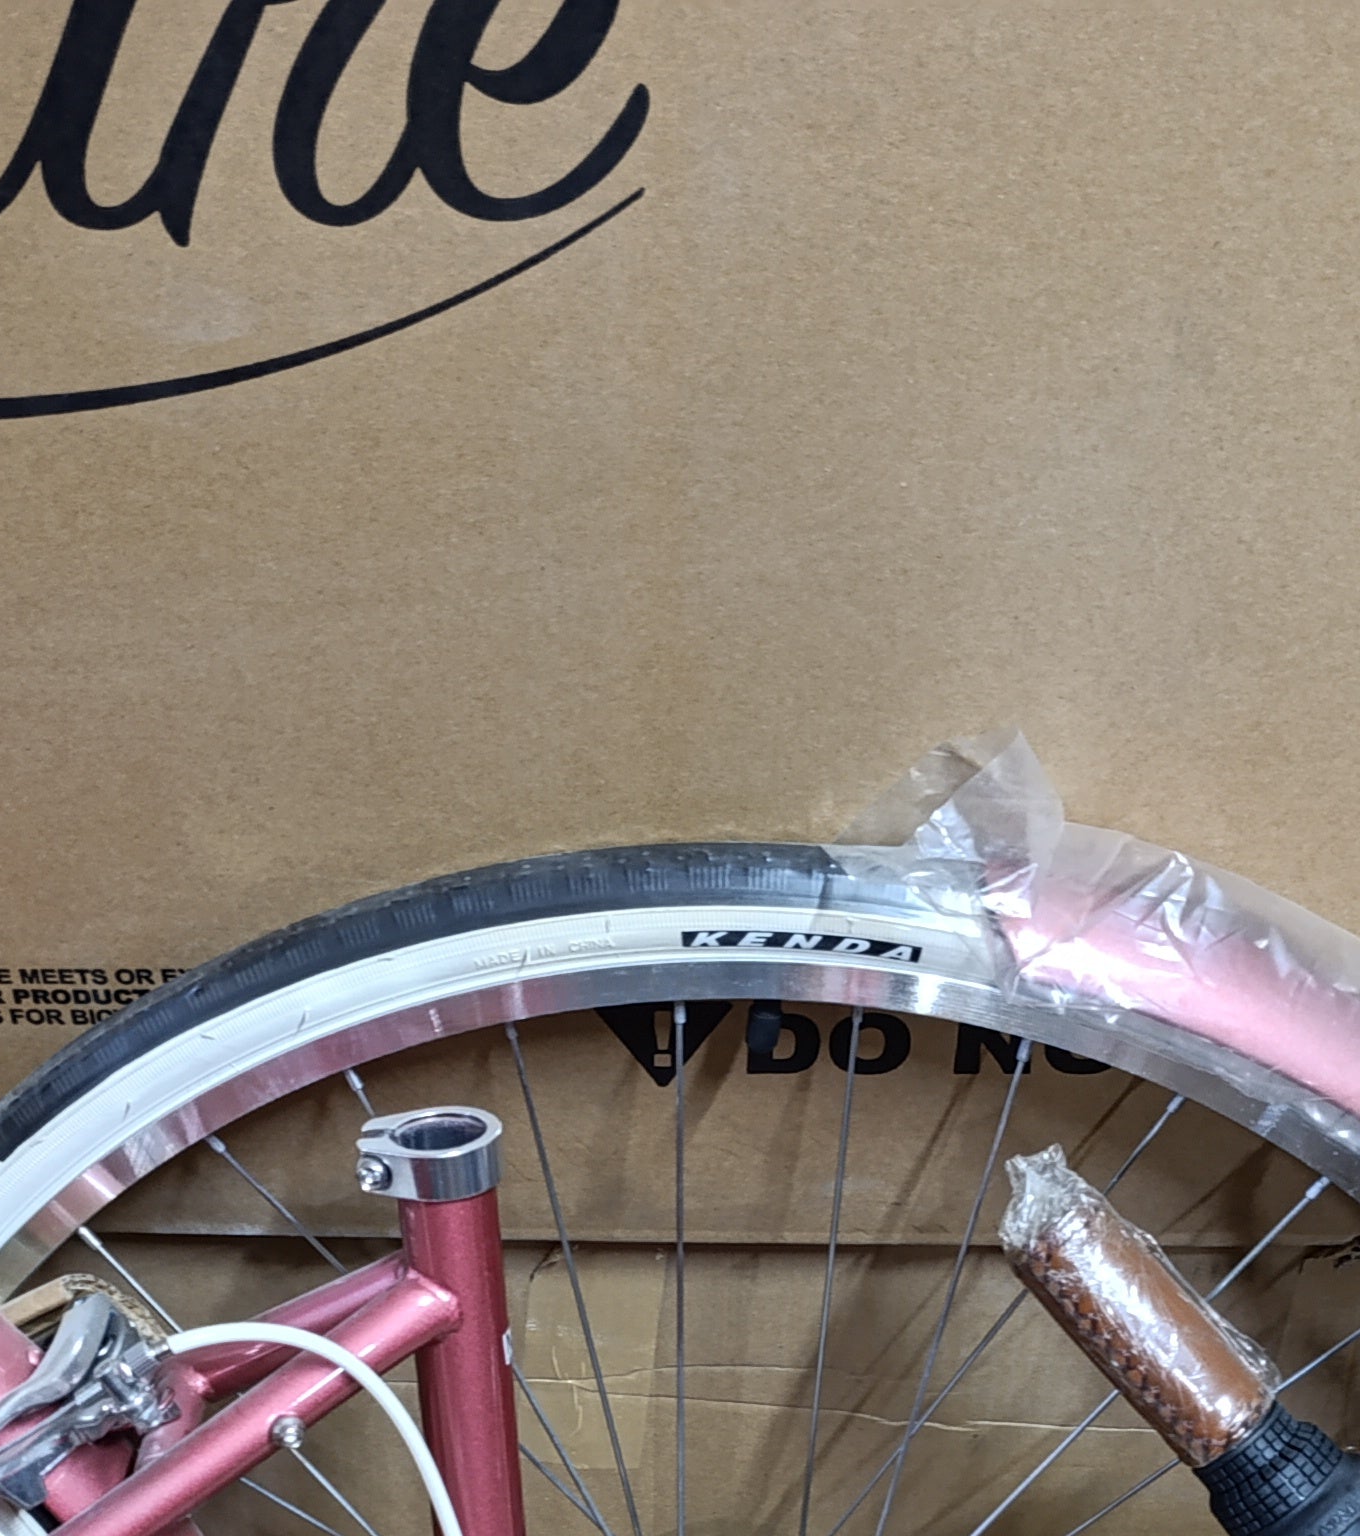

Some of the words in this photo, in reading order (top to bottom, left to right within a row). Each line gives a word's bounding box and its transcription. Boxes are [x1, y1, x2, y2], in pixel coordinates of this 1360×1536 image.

[690, 931, 918, 962] KENDA
[18, 968, 109, 986] MEETS
[114, 968, 156, 986] OR
[8, 1008, 66, 1026] FOR
